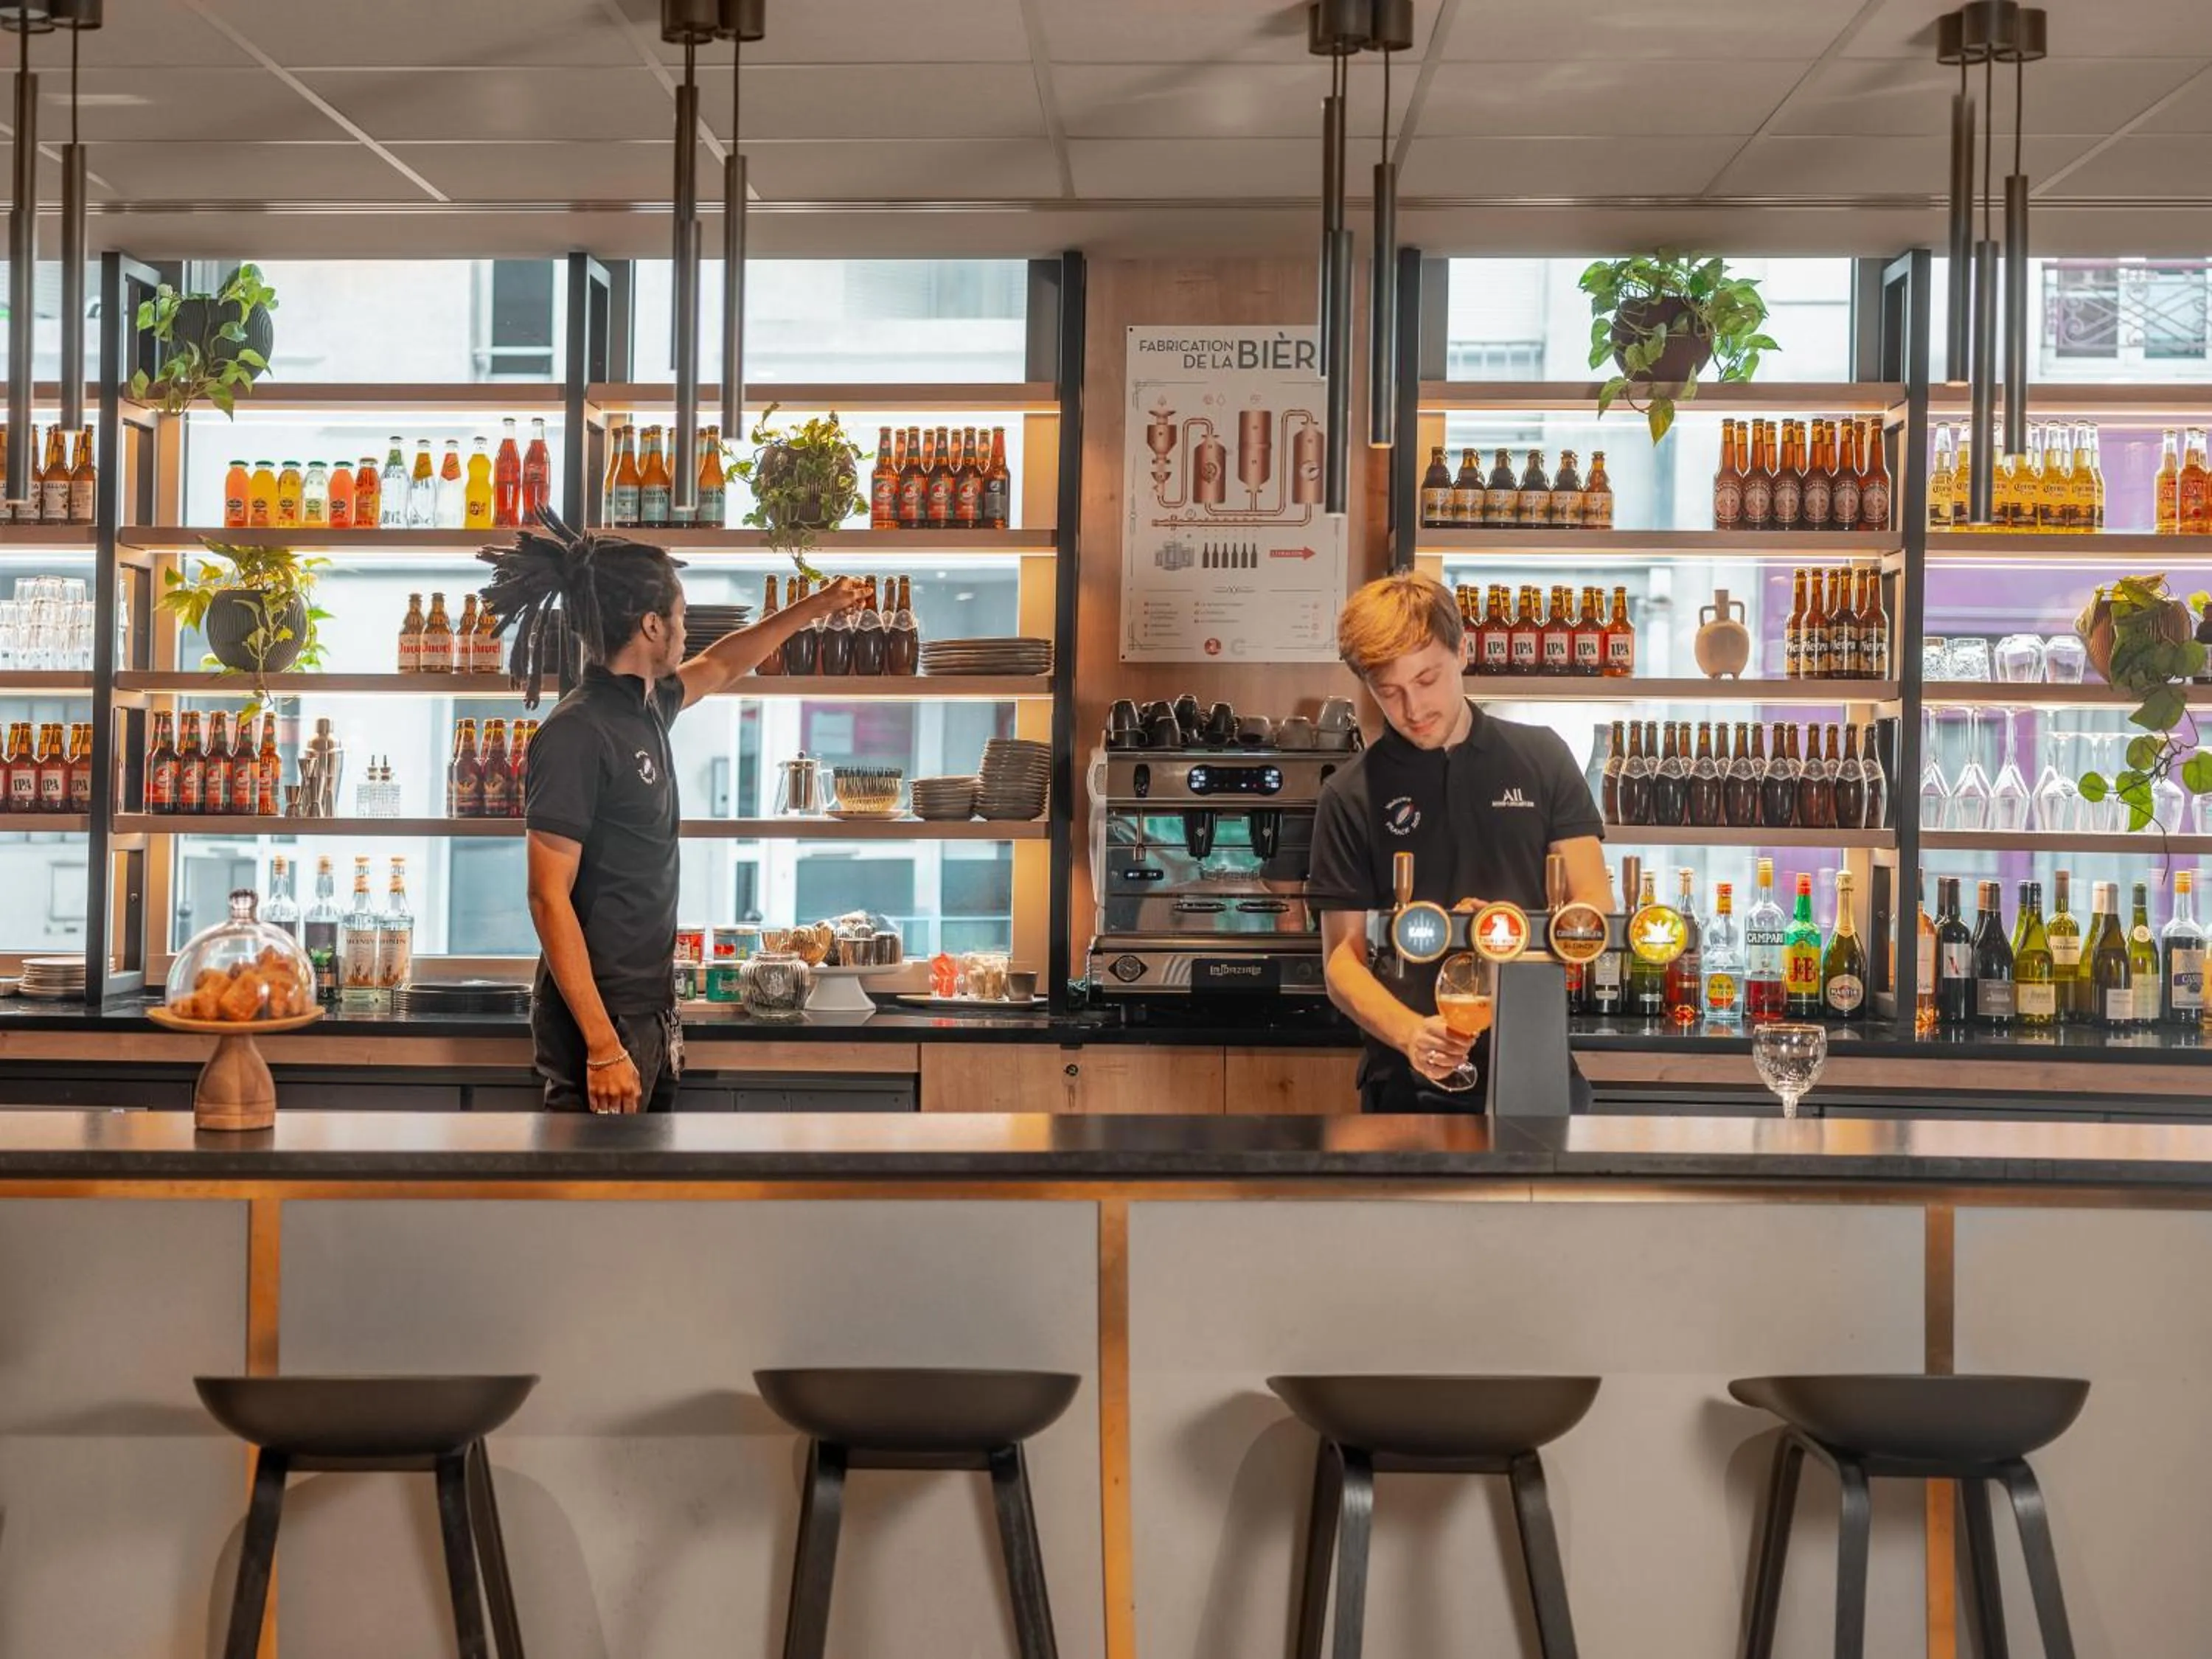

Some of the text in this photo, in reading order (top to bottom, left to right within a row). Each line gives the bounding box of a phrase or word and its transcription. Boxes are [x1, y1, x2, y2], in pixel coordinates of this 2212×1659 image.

[1139, 340, 1234, 352] FABRICATION
[1237, 331, 1316, 369] BIÈR
[1183, 354, 1234, 369] DE LA
[1487, 641, 1506, 655] IPA
[1514, 641, 1534, 655] IPA
[1546, 641, 1565, 655] IPA
[1578, 642, 1596, 655] IPA
[1611, 643, 1630, 656] IPA
[13, 778, 32, 791] IPA
[1503, 787, 1523, 801] All
[1747, 932, 1784, 944] CAMPARI
